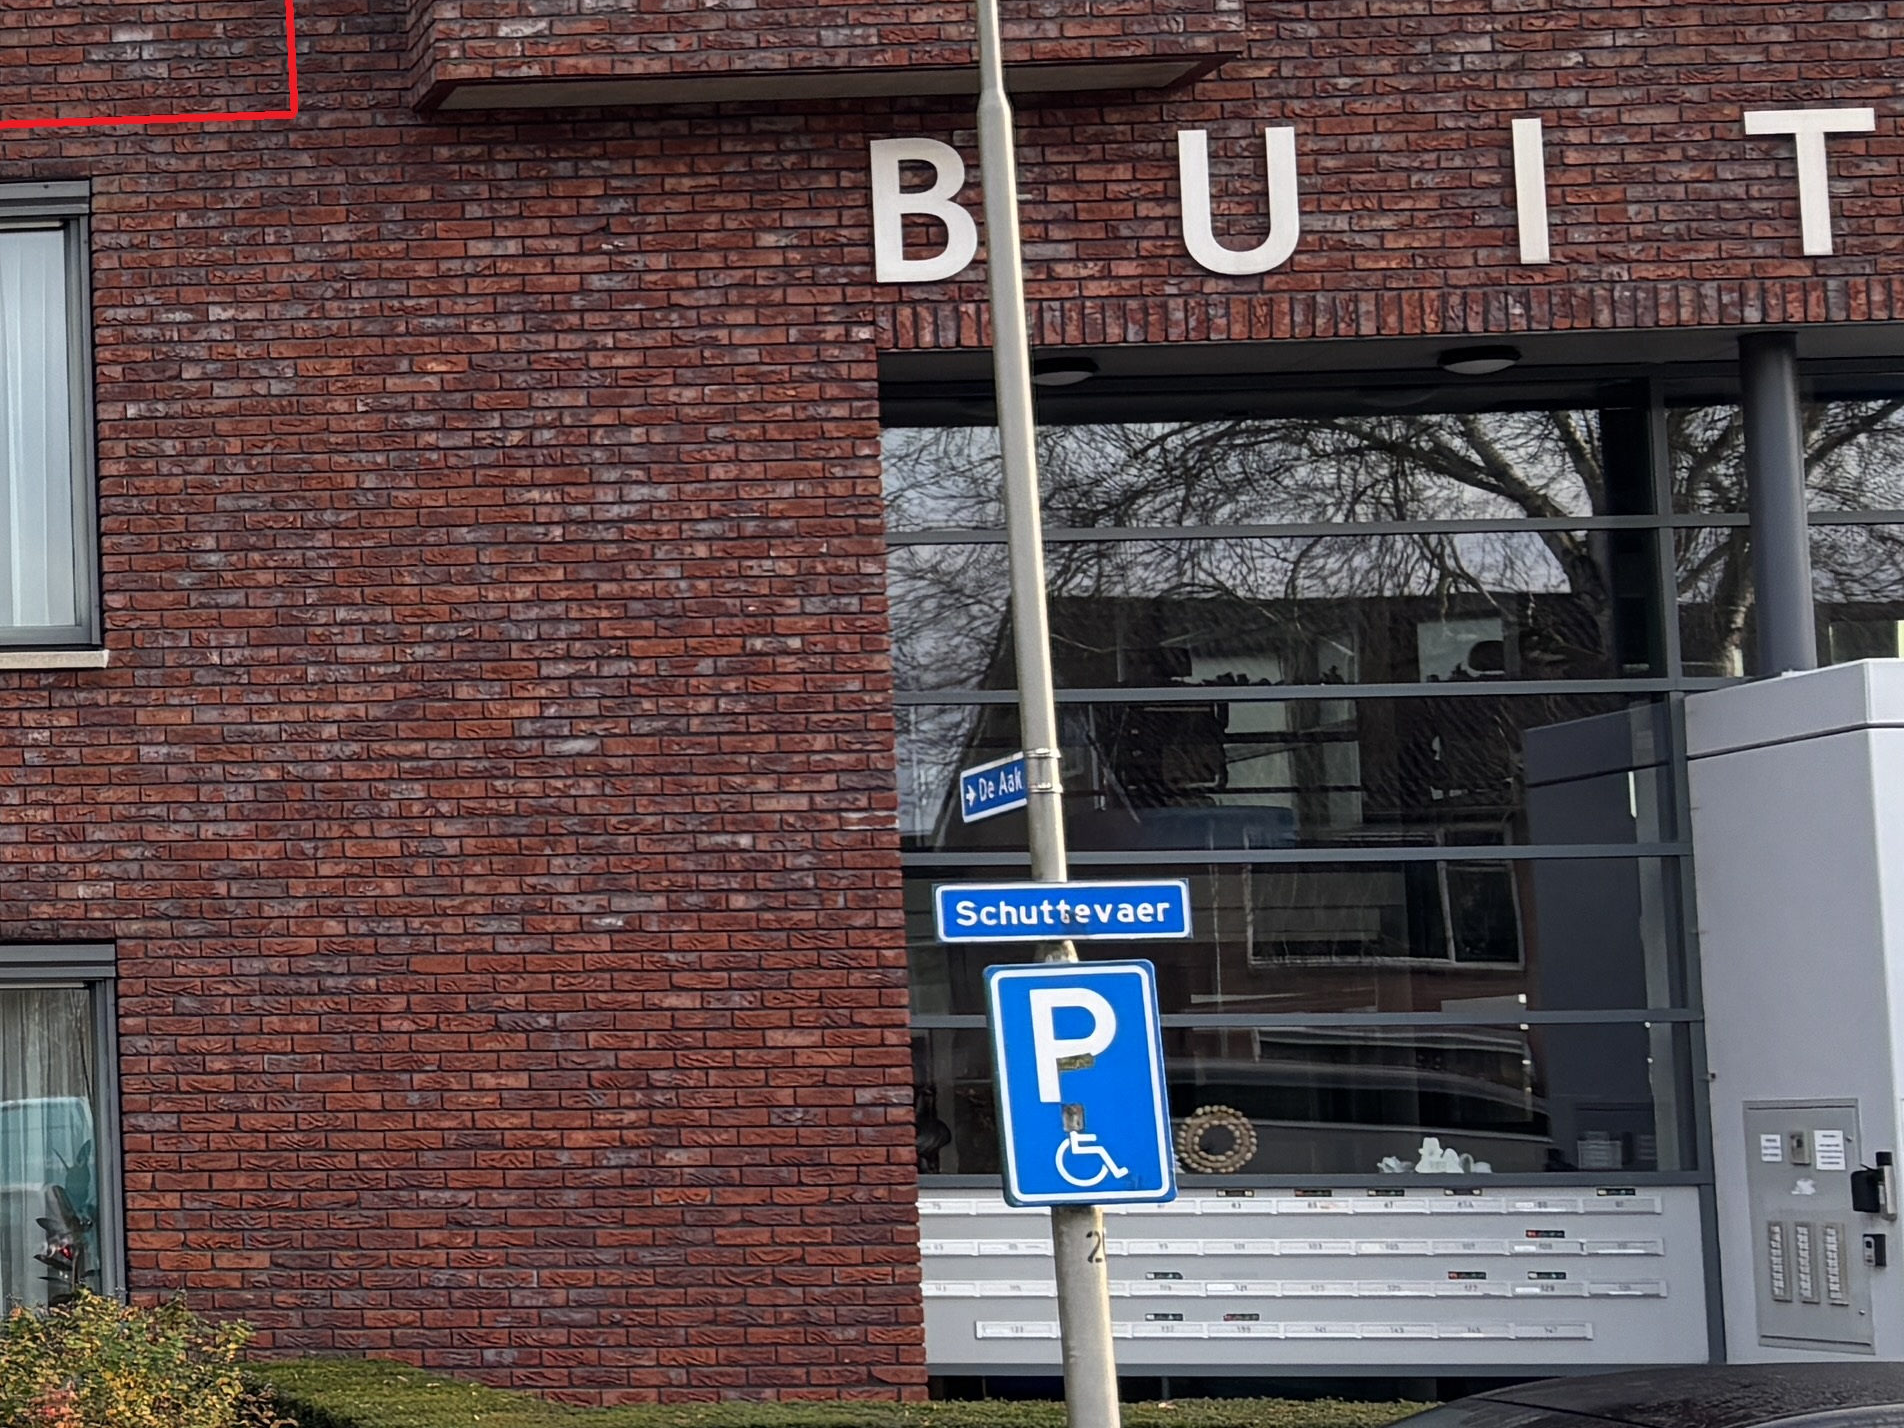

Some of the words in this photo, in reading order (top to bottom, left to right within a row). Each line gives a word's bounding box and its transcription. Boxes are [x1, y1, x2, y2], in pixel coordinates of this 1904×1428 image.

[870, 106, 1876, 283] BUIT
[978, 777, 995, 802] De
[998, 766, 1023, 796] Aak
[955, 899, 1170, 926] Schuttevaer
[1029, 987, 1117, 1103] P
